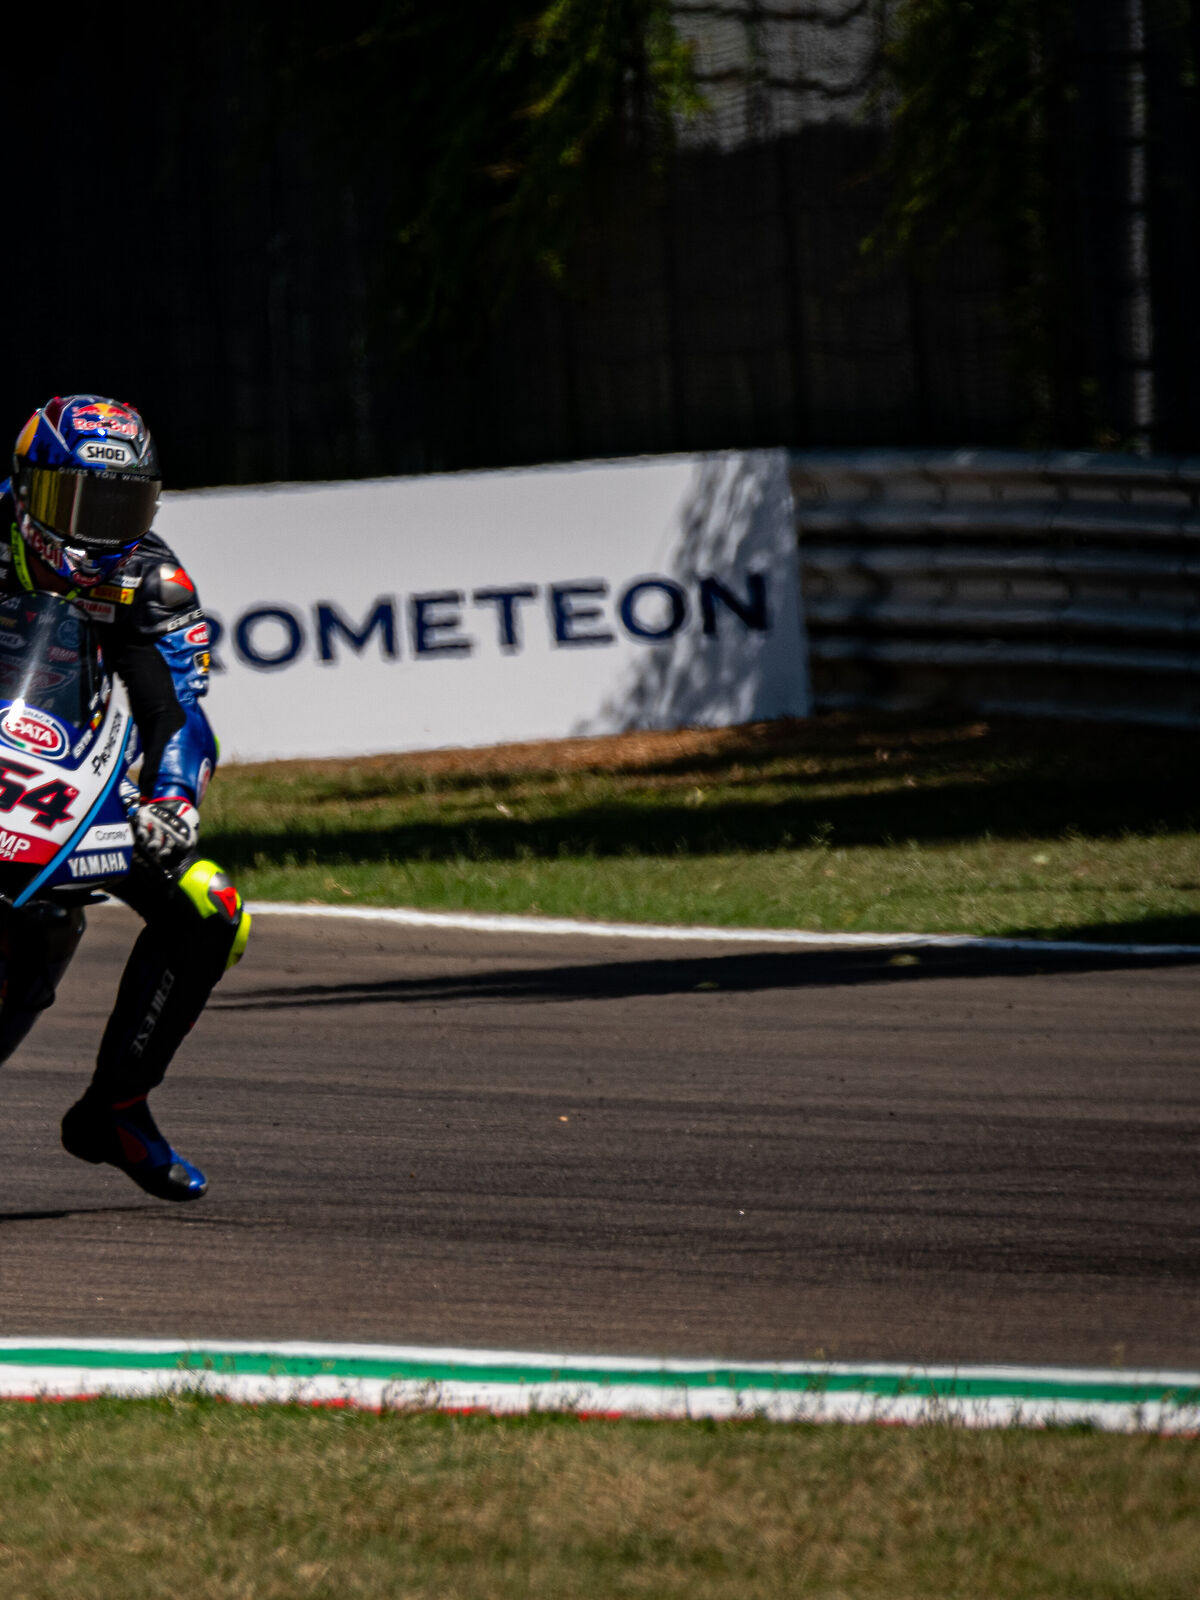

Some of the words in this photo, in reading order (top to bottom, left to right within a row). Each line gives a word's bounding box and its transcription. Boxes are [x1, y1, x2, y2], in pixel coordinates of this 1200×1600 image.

[87, 446, 125, 461] SHOEI
[205, 572, 767, 672] OMETEON
[14, 722, 52, 747] PATA
[67, 851, 128, 878] YAMAHA
